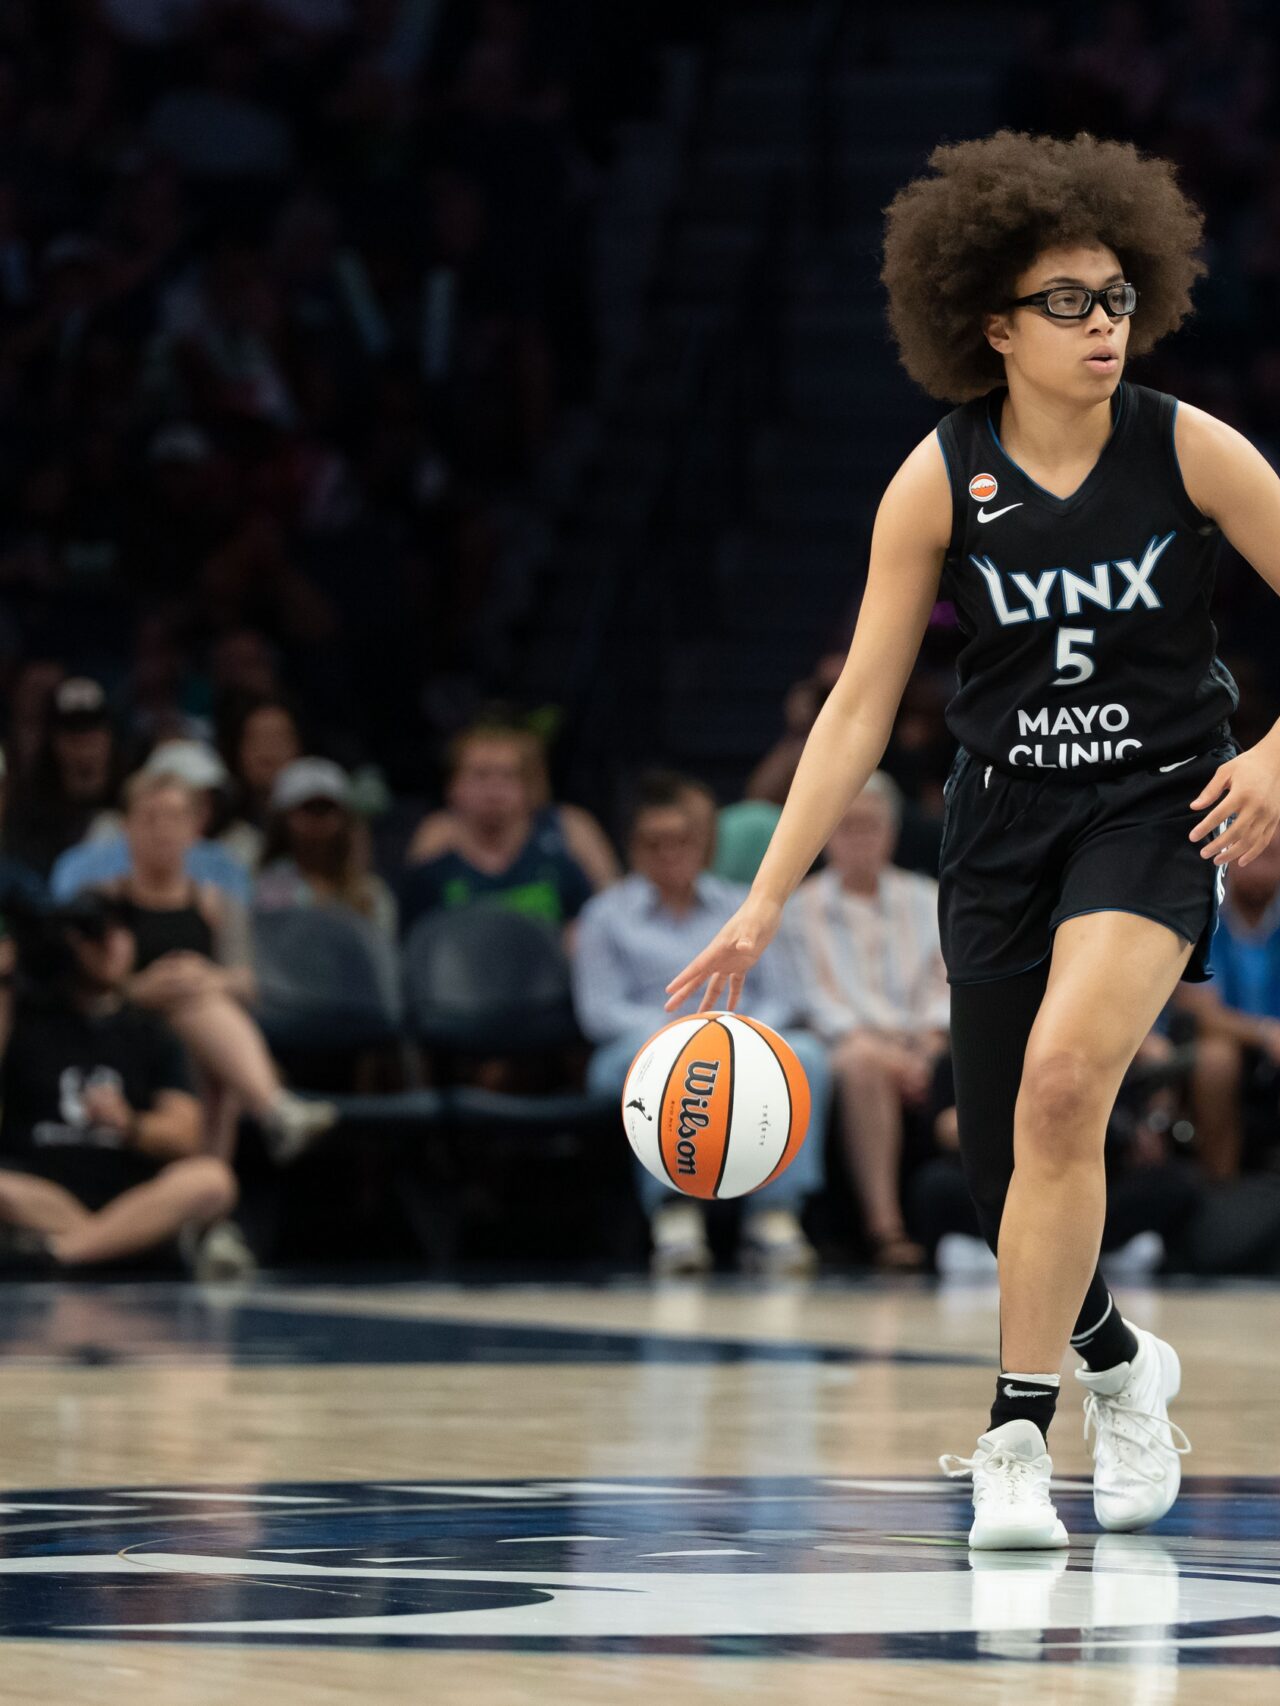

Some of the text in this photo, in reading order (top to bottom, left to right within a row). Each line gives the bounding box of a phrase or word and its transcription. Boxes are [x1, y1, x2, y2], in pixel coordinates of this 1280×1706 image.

[969, 531, 1176, 625] LYNX
[1052, 627, 1095, 686] 5
[1017, 703, 1130, 736] MAYO
[676, 1059, 720, 1176] Wilson
